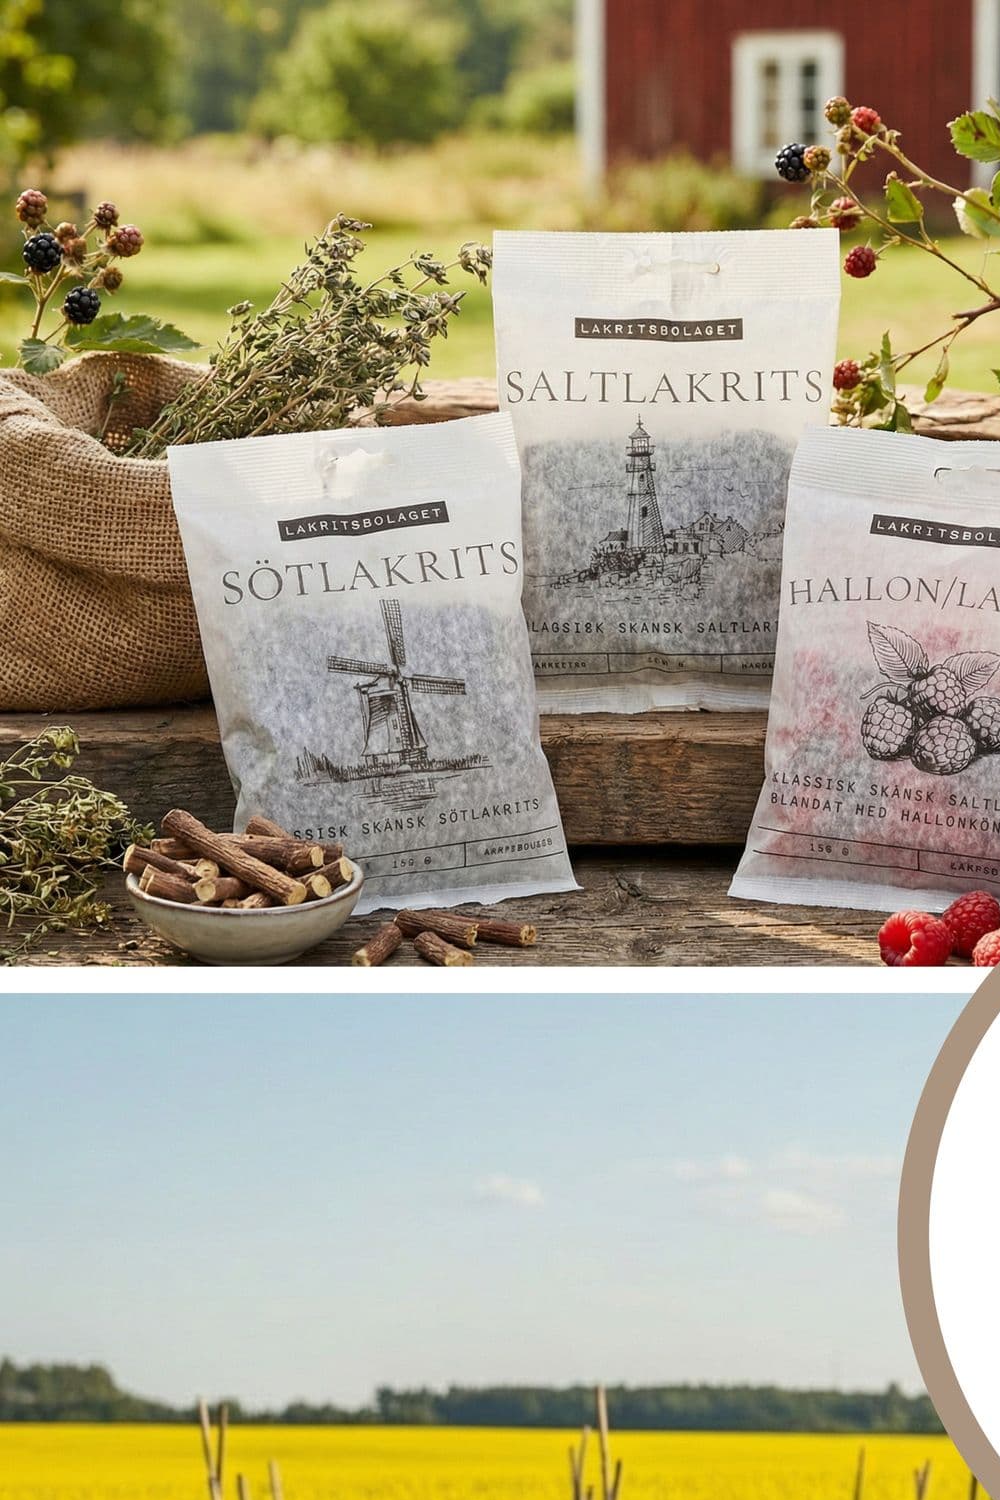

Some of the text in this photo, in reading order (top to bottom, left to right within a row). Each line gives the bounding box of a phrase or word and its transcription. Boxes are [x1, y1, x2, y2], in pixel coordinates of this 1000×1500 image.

[580, 322, 738, 337] LAKRITSBOLAGET
[505, 370, 824, 404] SALTLAKRITS
[285, 507, 442, 536] LAKRITSBOLAGET
[222, 540, 519, 606] SÖTLAKRITS
[439, 798, 540, 825] SÖTLAKRITS
[770, 792, 843, 813] BLANDAT
